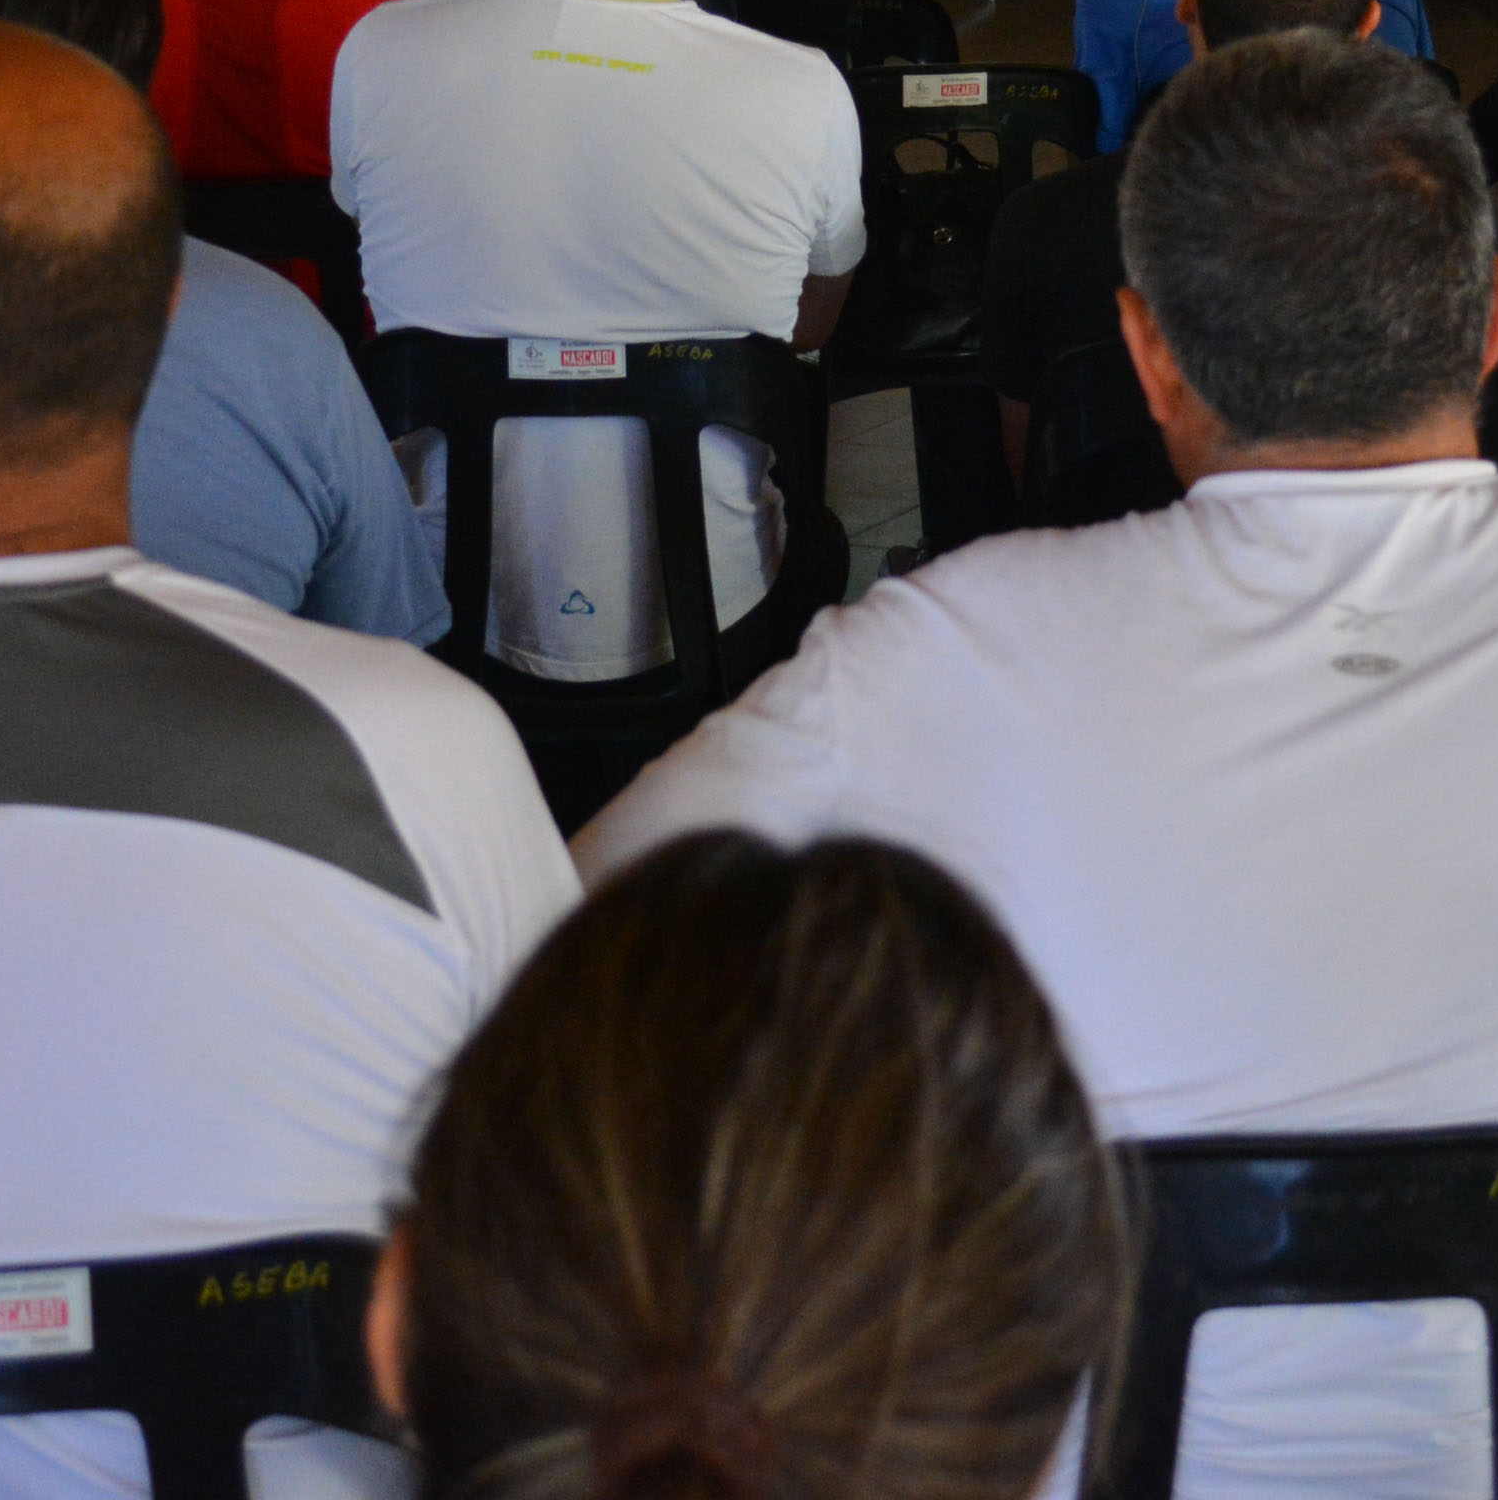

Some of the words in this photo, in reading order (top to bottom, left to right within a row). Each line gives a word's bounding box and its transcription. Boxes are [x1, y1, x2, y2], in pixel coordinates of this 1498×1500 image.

[942, 85, 979, 96] MASCARDI
[563, 351, 614, 365] MASCARDI
[648, 343, 713, 360] ASEBA
[200, 1260, 331, 1304] ASEBA
